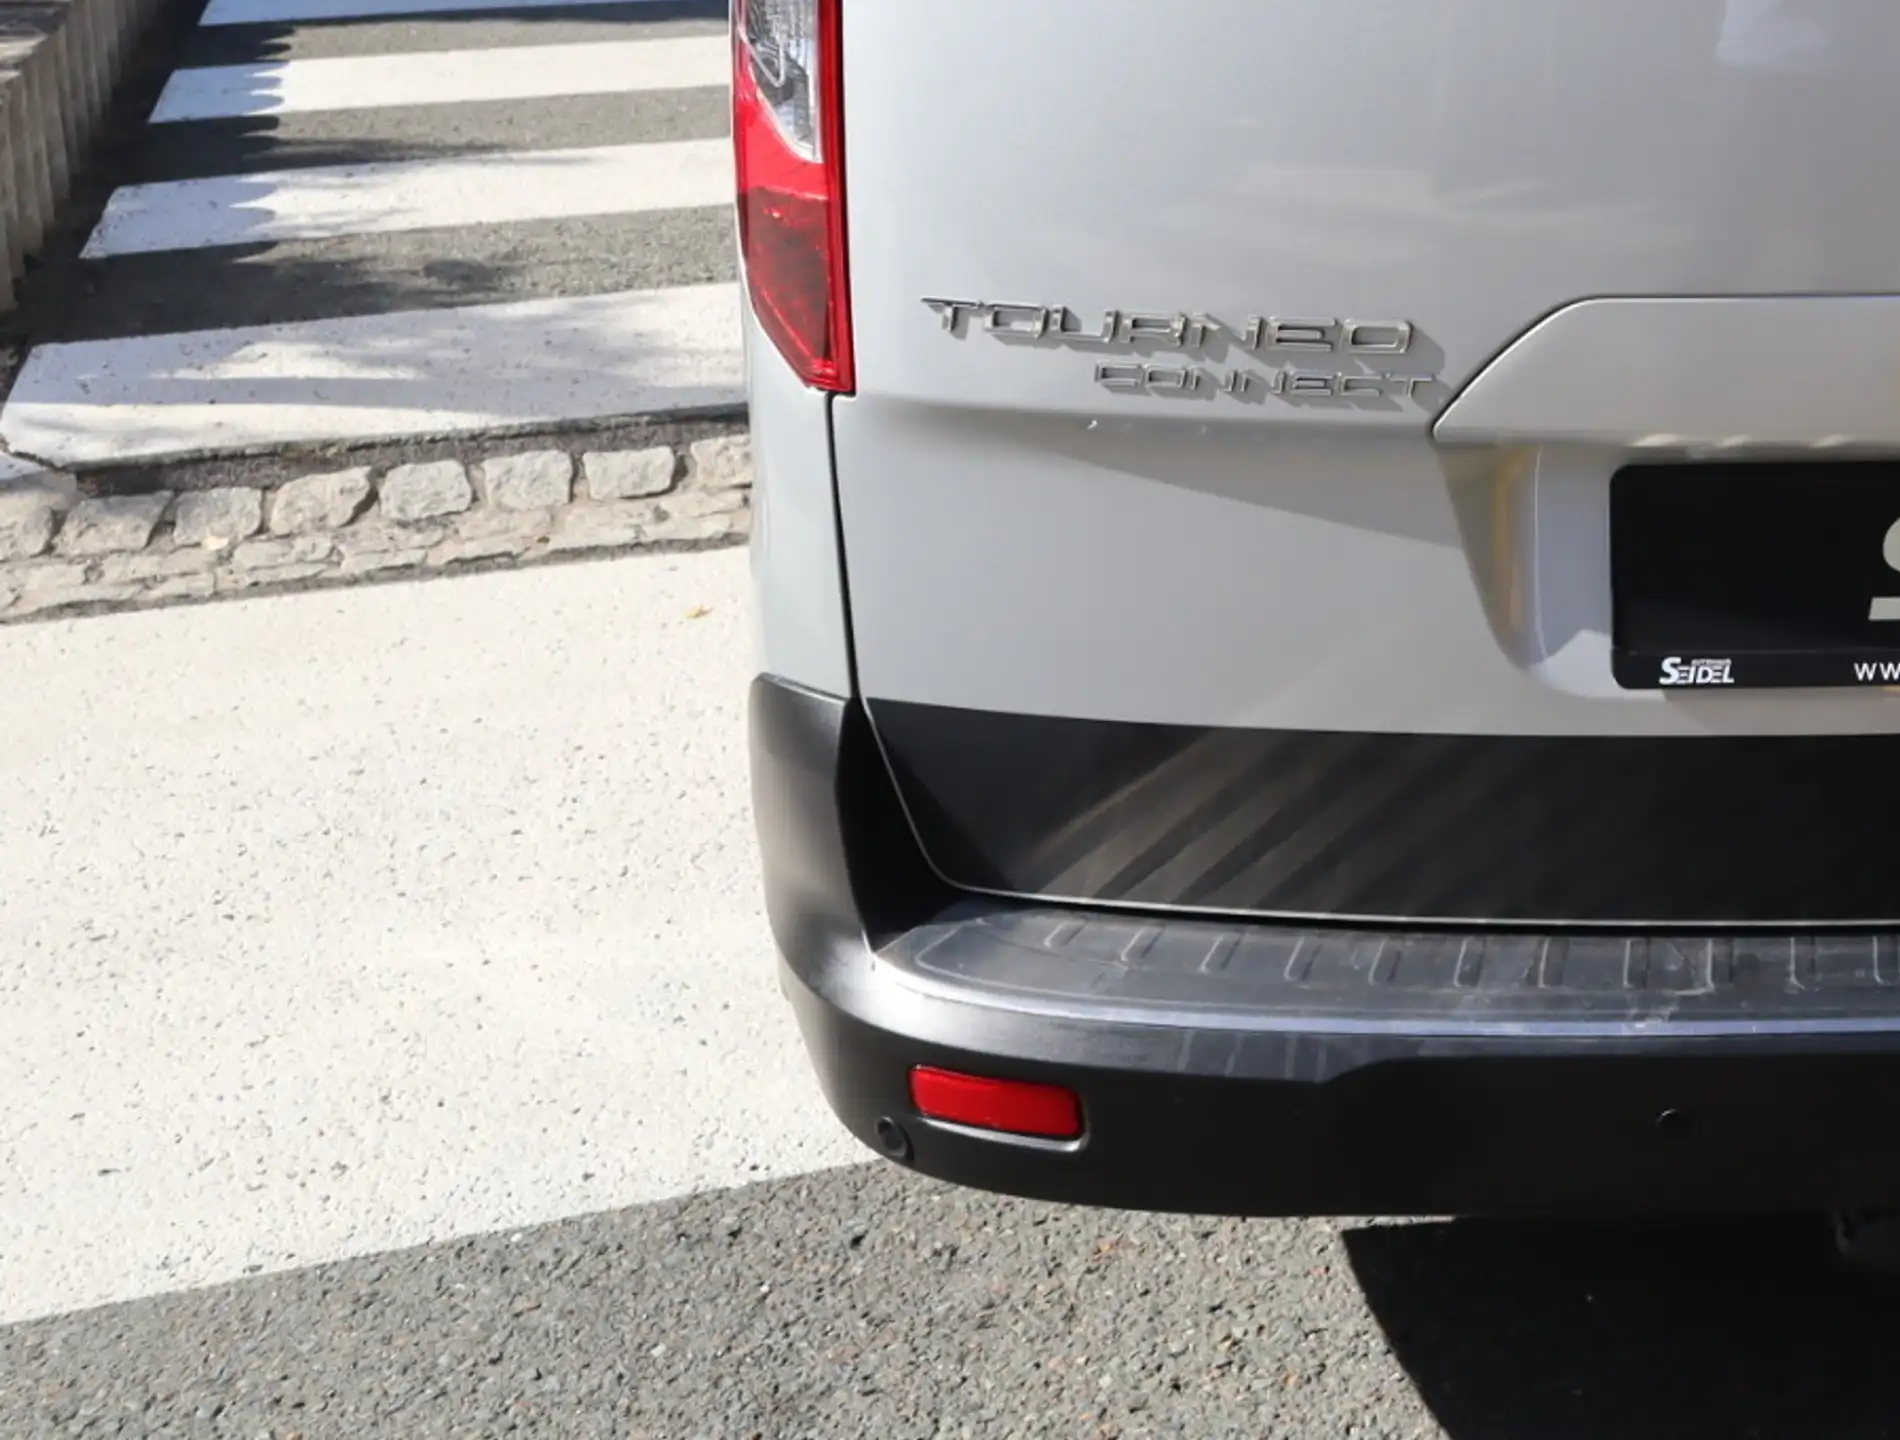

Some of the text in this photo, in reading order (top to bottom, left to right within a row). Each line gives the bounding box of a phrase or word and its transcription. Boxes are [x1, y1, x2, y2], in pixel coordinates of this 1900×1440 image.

[921, 297, 1412, 353] TOURNEO
[1094, 363, 1434, 398] CONNECT
[1659, 656, 1735, 685] SEIDEL
